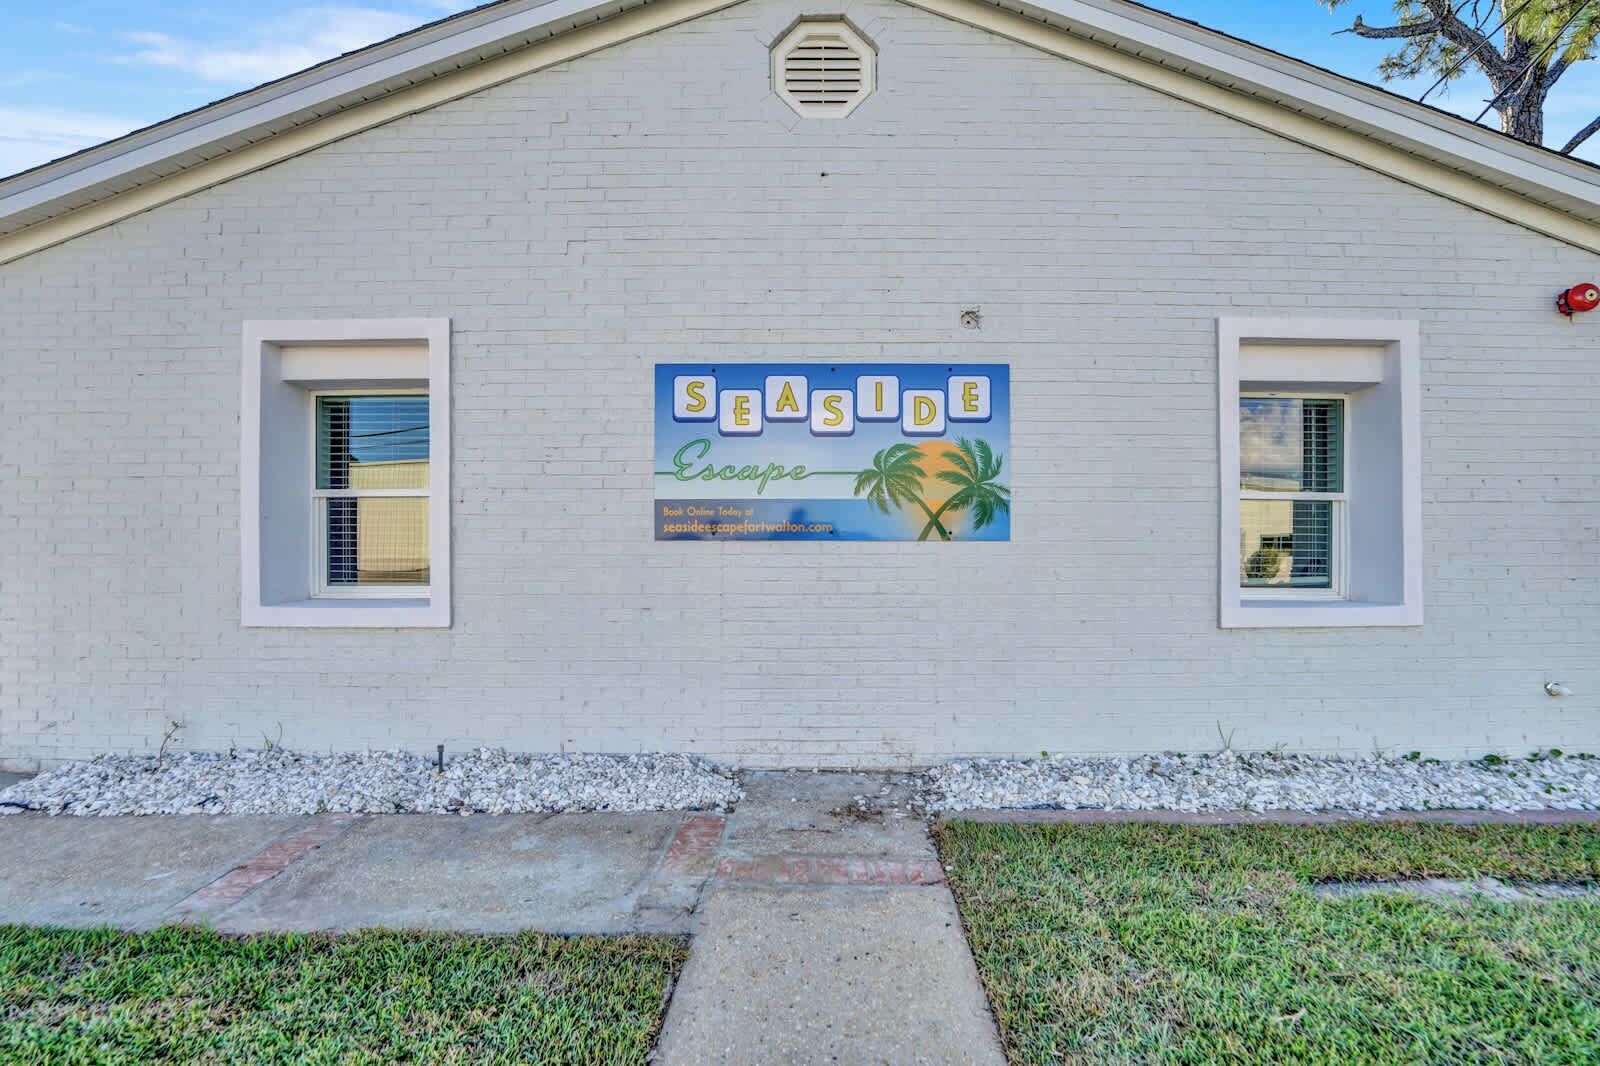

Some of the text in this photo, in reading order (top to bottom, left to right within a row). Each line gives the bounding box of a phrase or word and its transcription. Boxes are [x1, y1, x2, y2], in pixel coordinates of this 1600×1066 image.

[685, 380, 979, 427] SEASIDE
[672, 438, 812, 494] Escape
[663, 505, 755, 519] Book Online Today at
